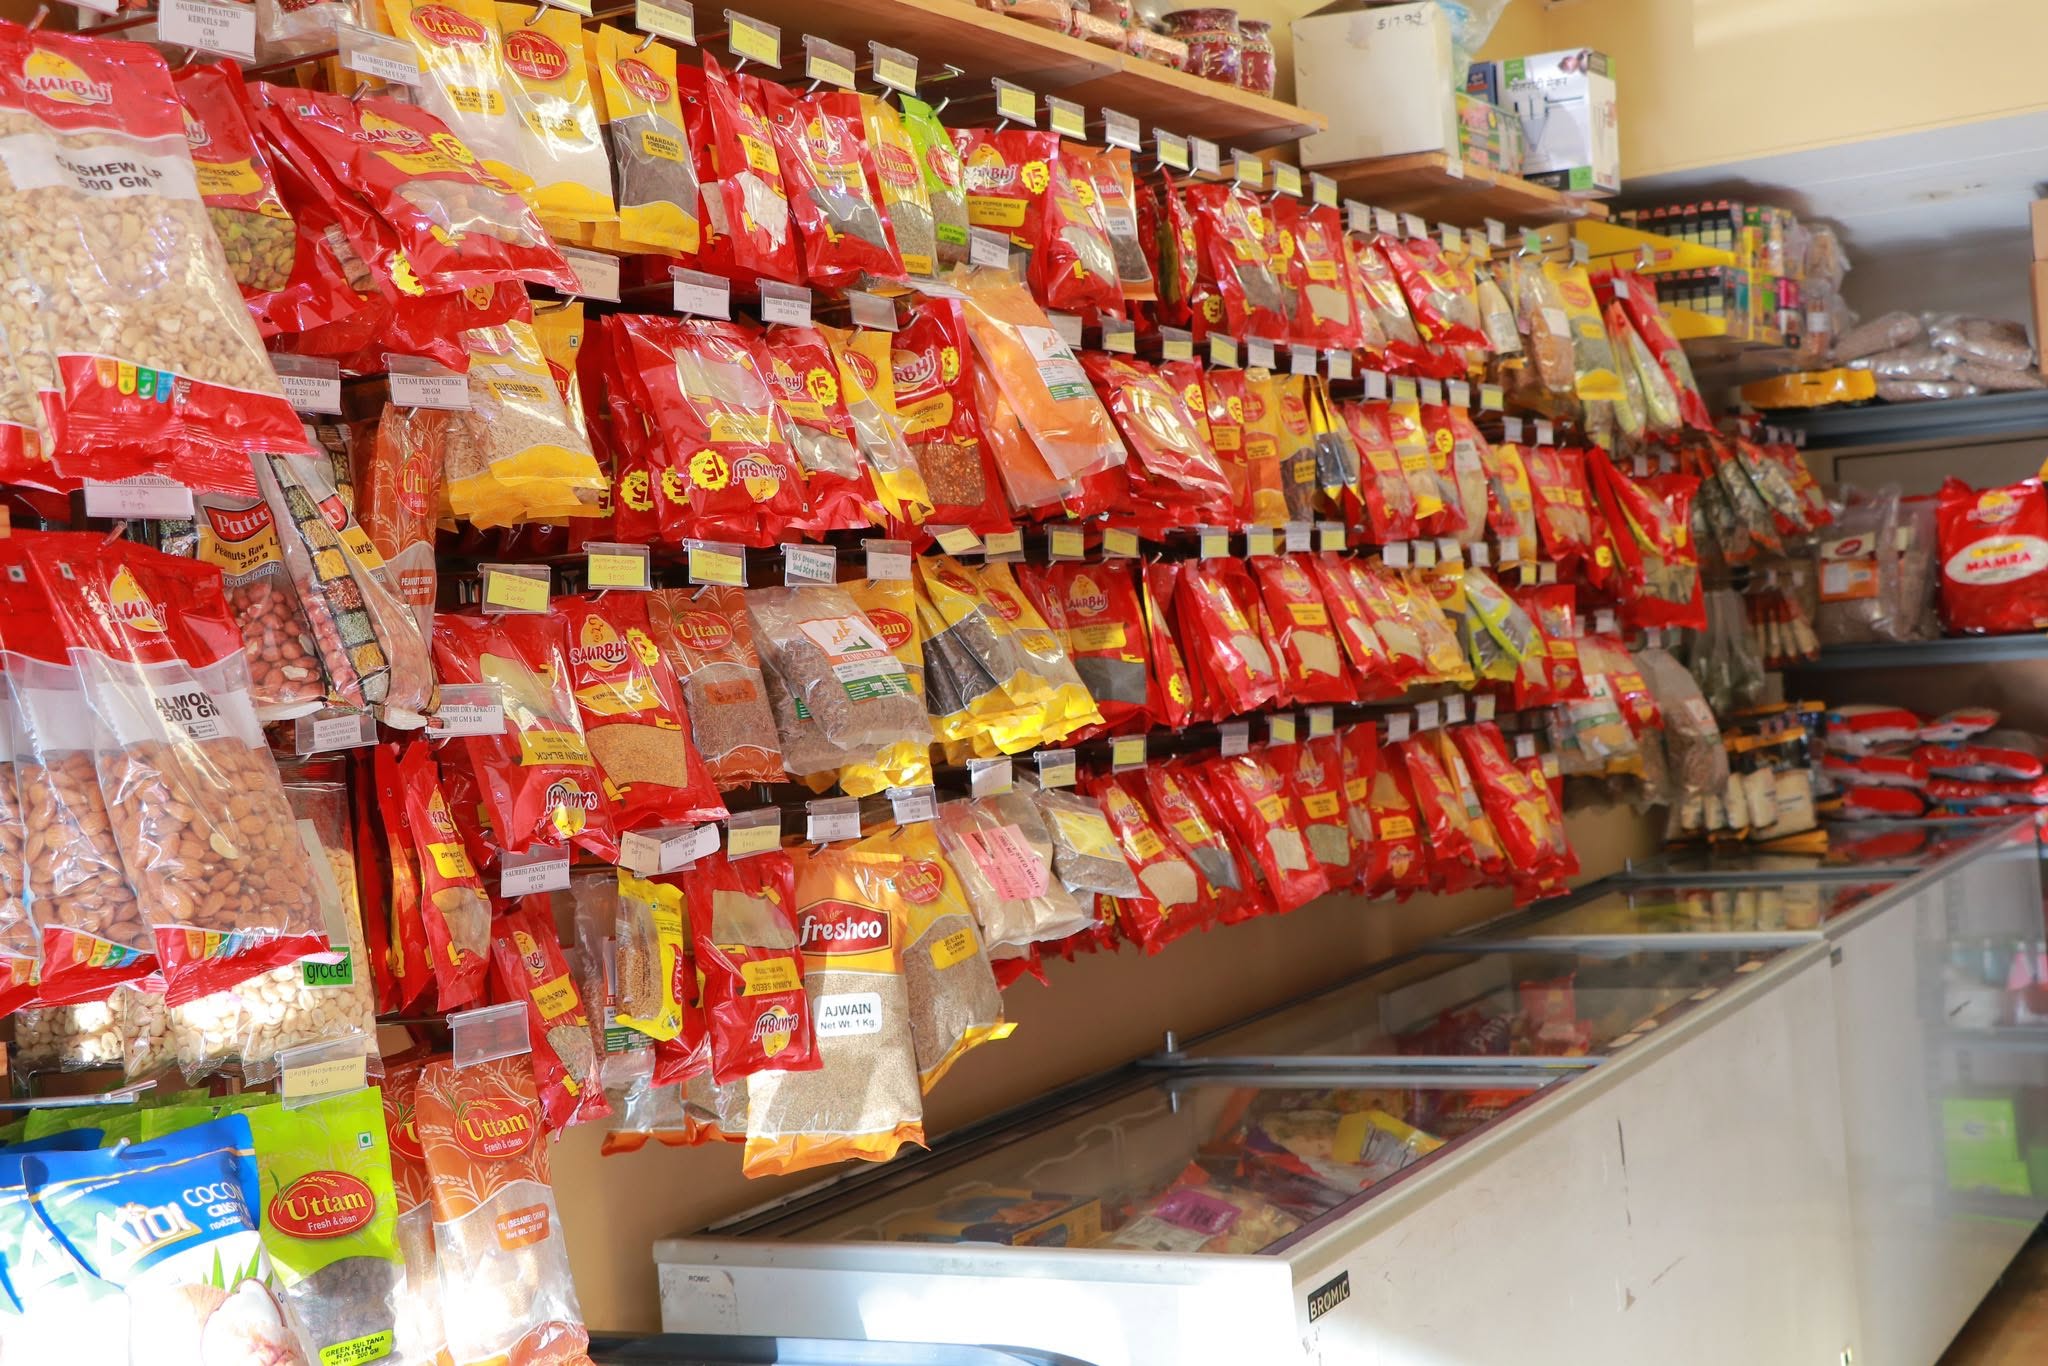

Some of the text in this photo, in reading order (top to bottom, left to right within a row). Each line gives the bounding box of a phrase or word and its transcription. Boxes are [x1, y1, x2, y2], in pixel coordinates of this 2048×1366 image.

[419, 15, 480, 38] Uttam
[506, 43, 561, 67] Uttam
[20, 74, 113, 105] AURBHi
[56, 155, 138, 177] CASHEW
[77, 175, 152, 191] 500 GM
[1027, 168, 1044, 190] 15
[982, 200, 1002, 208] PEPPER
[1003, 202, 1021, 210] WHOLE
[286, 377, 316, 387] PEANUTS
[317, 380, 331, 388] RAW
[397, 377, 418, 386] UTTAM
[418, 378, 441, 386] PEANUT
[493, 382, 542, 394] CUCUMBER
[766, 371, 804, 391] SABHi
[811, 376, 829, 400] 15
[431, 388, 441, 396] GM
[215, 506, 271, 537] Pattu
[214, 542, 265, 562] Peanuts Raw
[240, 551, 269, 570] 250 g
[401, 577, 419, 586] PEANUT
[678, 620, 729, 639] Uttam
[878, 621, 907, 636] tam
[154, 691, 214, 711] ALMON
[460, 705, 473, 713] DRY
[474, 705, 497, 713] APRICOT
[163, 708, 193, 722] 500
[536, 751, 589, 761] RAISIN BLACK
[528, 865, 546, 874] PANCH
[1027, 868, 1041, 889] WHITE
[801, 915, 882, 946] freshco
[943, 934, 965, 946] JEERA
[752, 983, 772, 992] SEEDS
[825, 1003, 872, 1018] AJWAIN
[752, 1012, 799, 1042] SAURBHi
[820, 1021, 836, 1030] Net
[855, 1019, 860, 1027] 1
[462, 1112, 530, 1143] Uttam
[483, 1142, 502, 1154] Fresh
[508, 1138, 524, 1148] clean
[284, 1191, 367, 1221] Uttam
[307, 1215, 358, 1232] Fresh & clean
[1310, 1280, 1349, 1320] BROMIC
[325, 1335, 385, 1358] GREEN SULTANA
[336, 1345, 372, 1360] RAISIN
